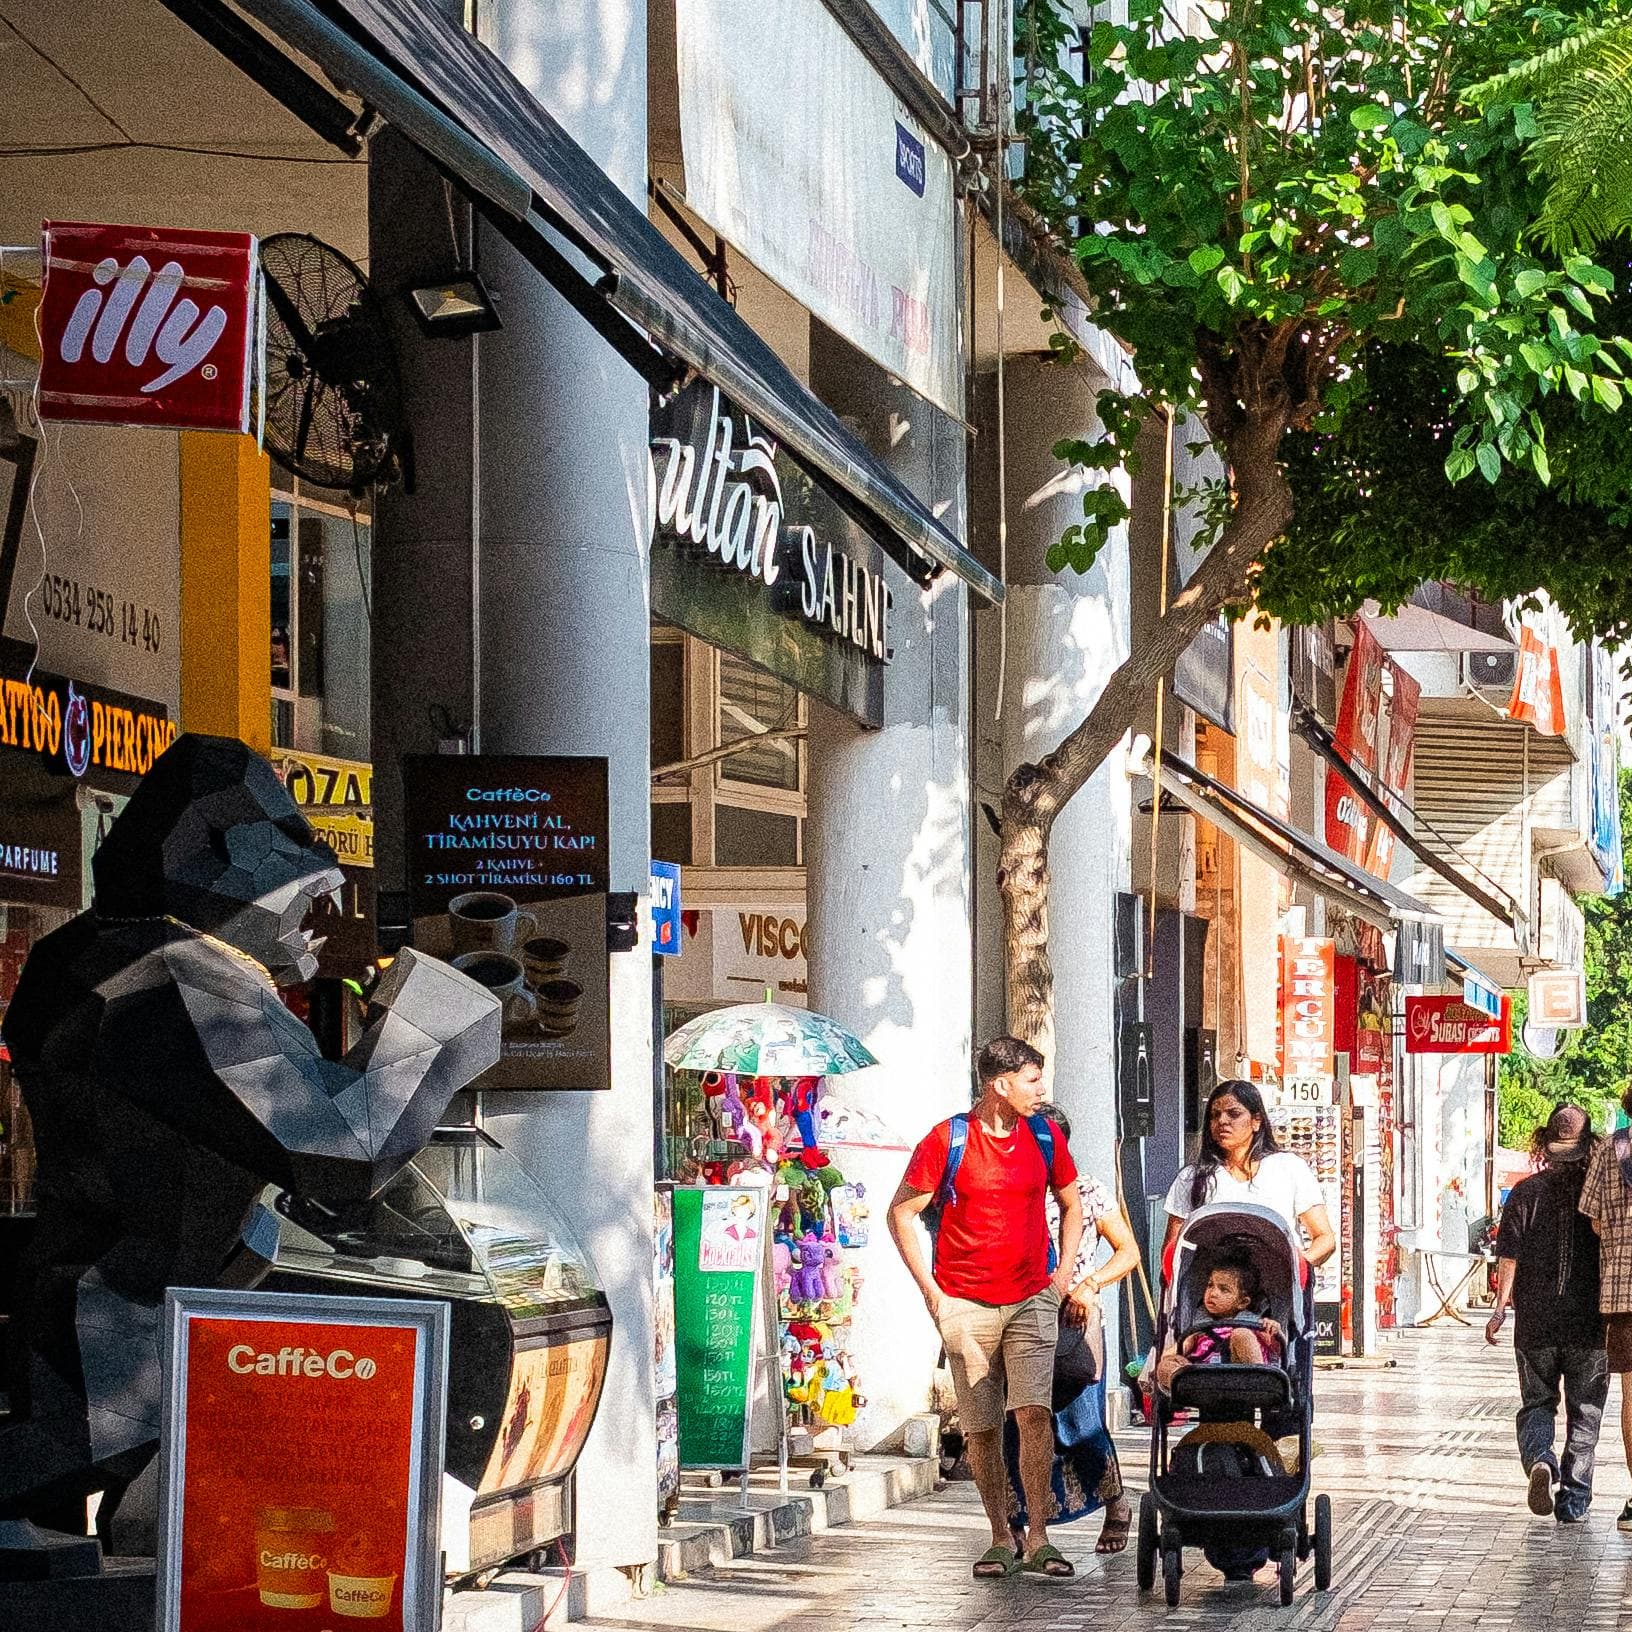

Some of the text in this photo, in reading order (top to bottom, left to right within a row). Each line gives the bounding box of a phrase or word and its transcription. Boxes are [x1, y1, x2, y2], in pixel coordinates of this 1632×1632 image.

[61, 256, 227, 393] illy
[648, 384, 783, 586] ultan
[43, 574, 161, 654] 0534 258 14 40
[286, 764, 374, 805] OZA
[466, 787, 551, 802] CaffèCo
[554, 835, 596, 850] KAP!
[424, 871, 595, 885] 2 SHOT TİRAMİSU 160 TL
[487, 859, 535, 871] KAHVE
[650, 875, 674, 910] NCY
[1543, 983, 1573, 1018] E
[1290, 1082, 1320, 1101] 150
[227, 1343, 377, 1381] CaffèCo
